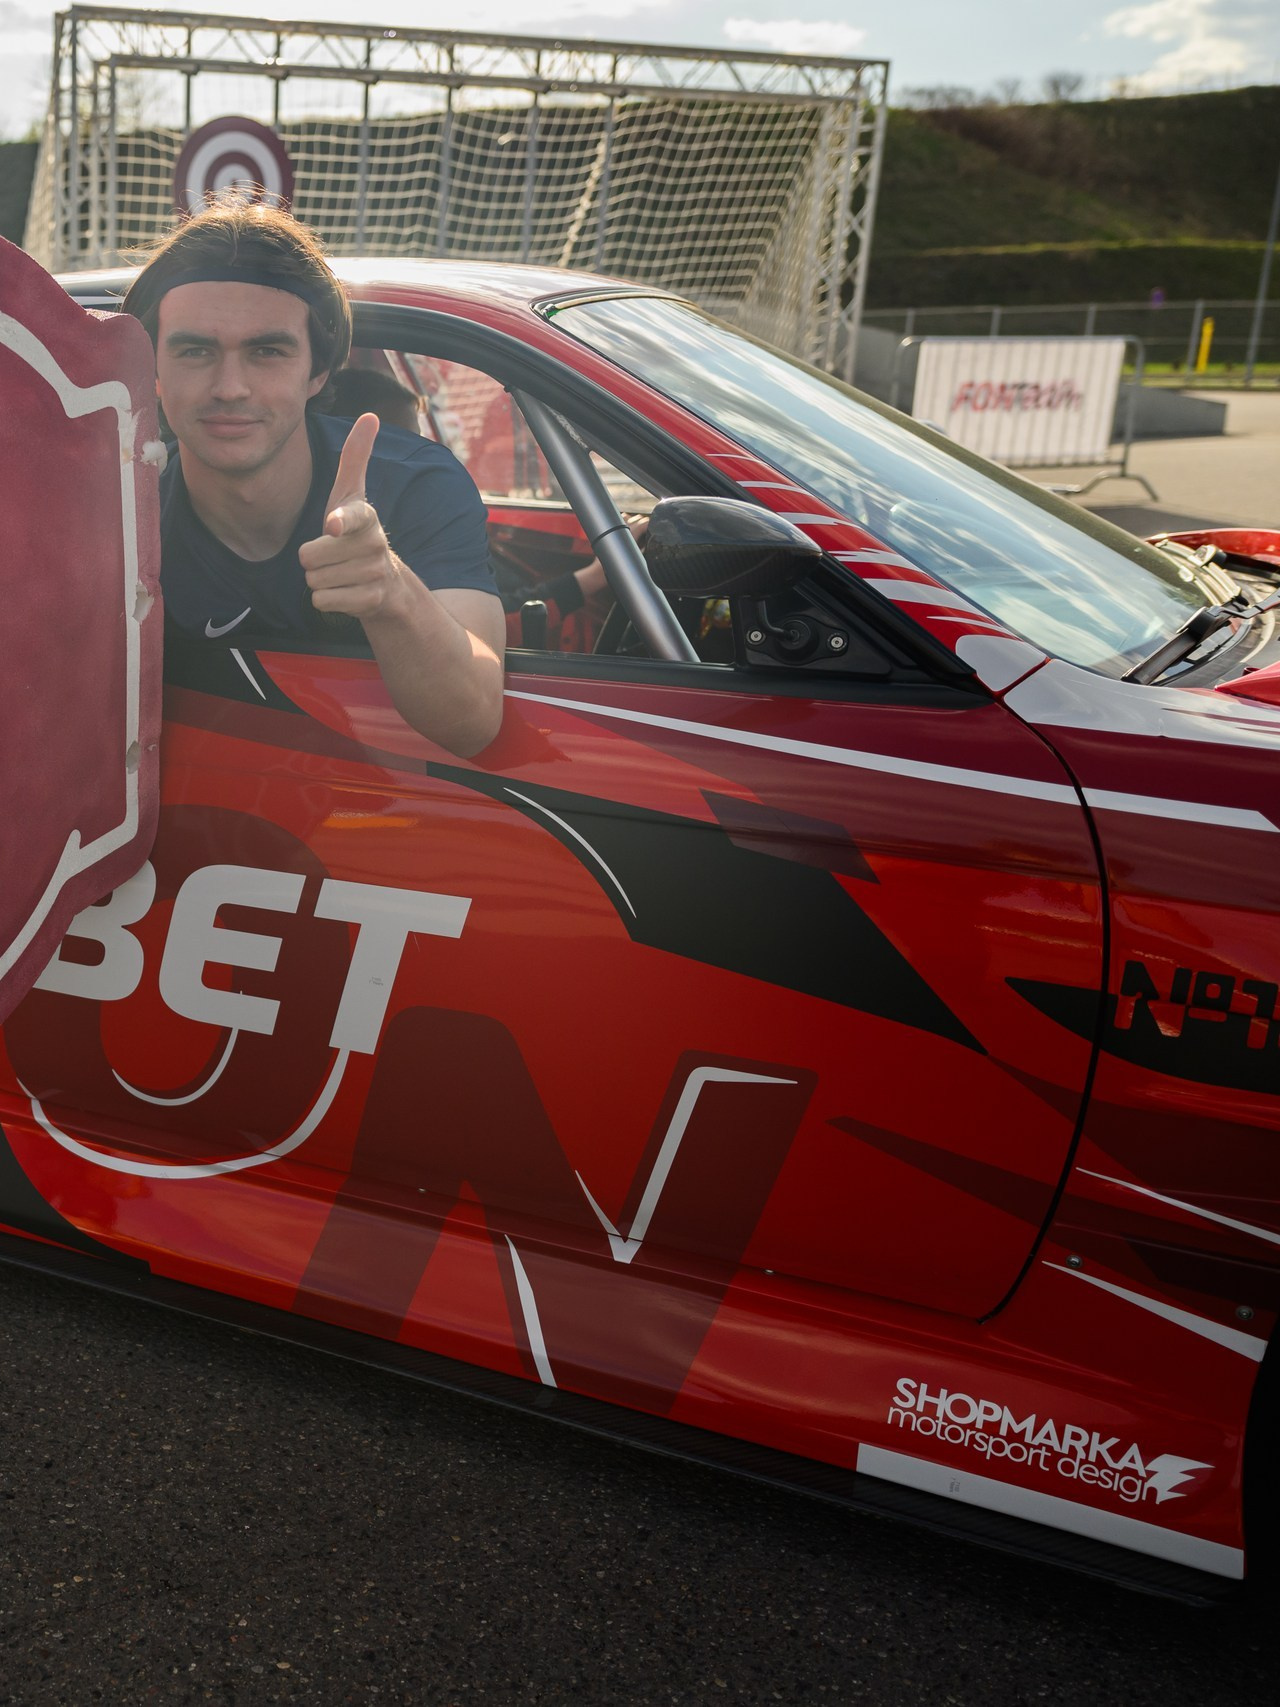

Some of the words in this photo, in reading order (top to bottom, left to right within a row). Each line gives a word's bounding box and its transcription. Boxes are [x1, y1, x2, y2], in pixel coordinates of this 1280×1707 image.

[32, 859, 472, 1055] BET
[887, 1406, 1049, 1472] motorsport
[1057, 1452, 1161, 1505] design
[893, 1377, 1147, 1477] SHOPMARKA
